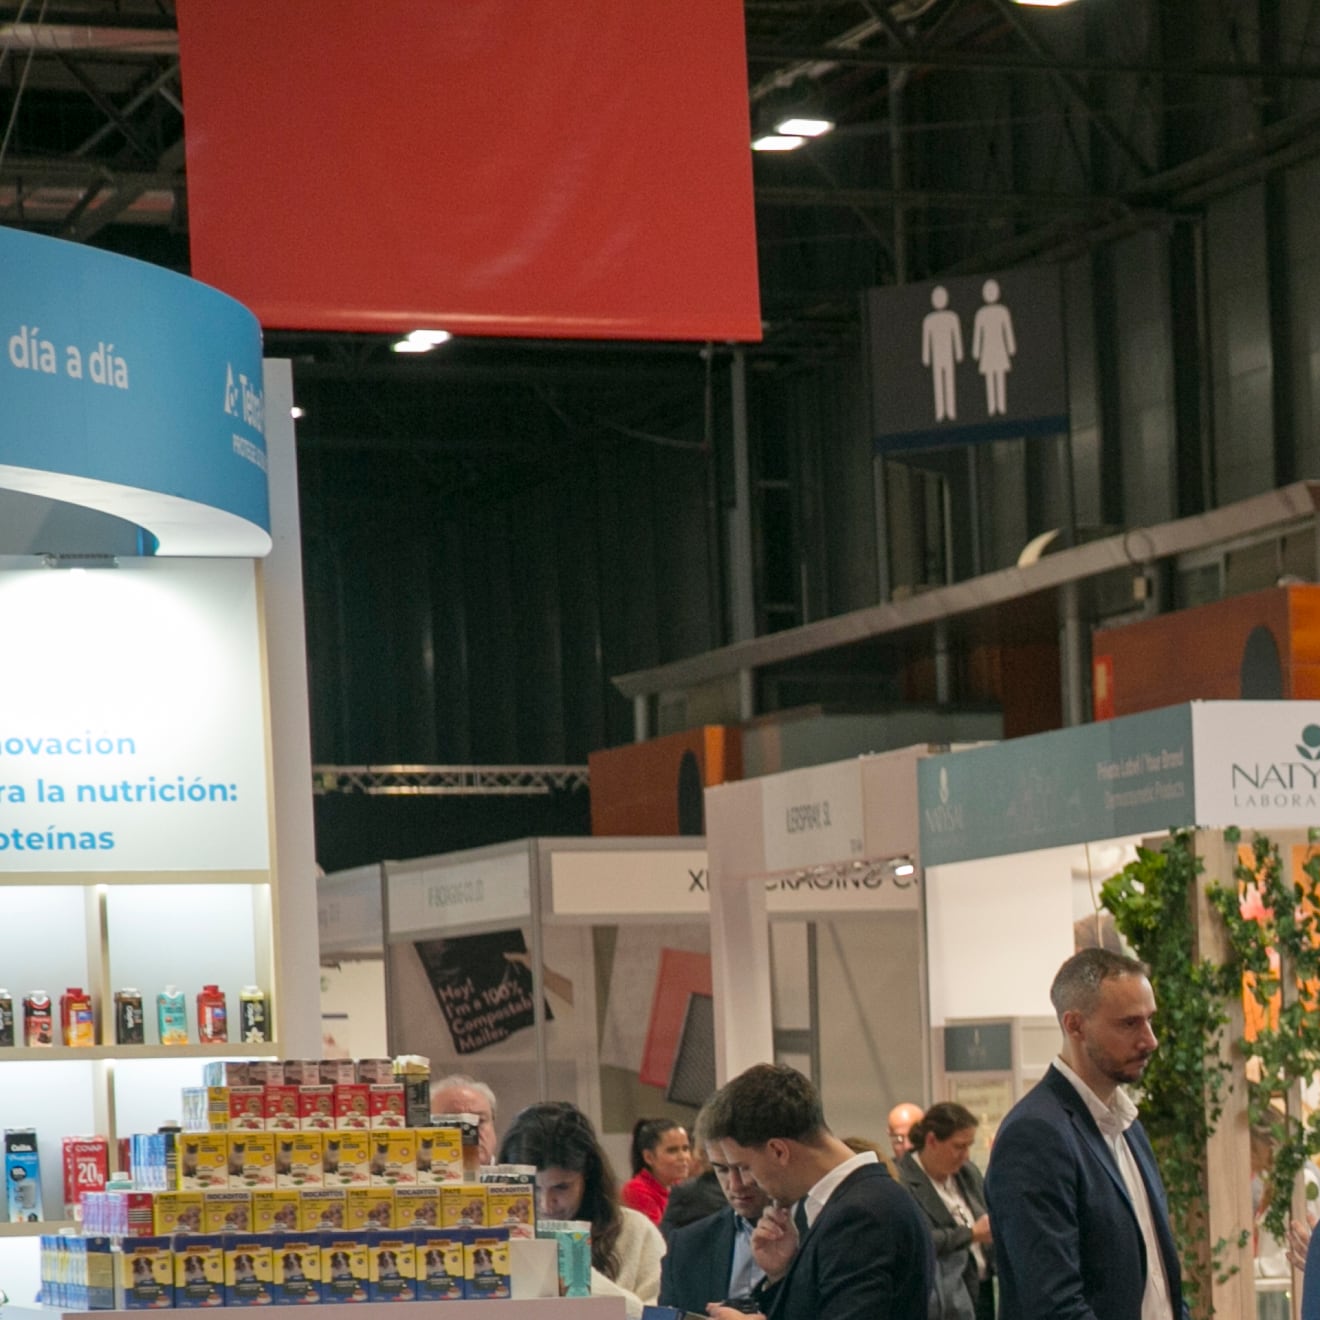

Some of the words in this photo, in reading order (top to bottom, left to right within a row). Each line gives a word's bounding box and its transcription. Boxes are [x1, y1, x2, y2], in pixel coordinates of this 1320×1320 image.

[9, 325, 56, 374] día
[66, 345, 82, 379] a
[89, 341, 129, 390] día
[0, 730, 136, 756] ovación
[37, 778, 65, 803] la
[77, 775, 238, 803] nutrición:
